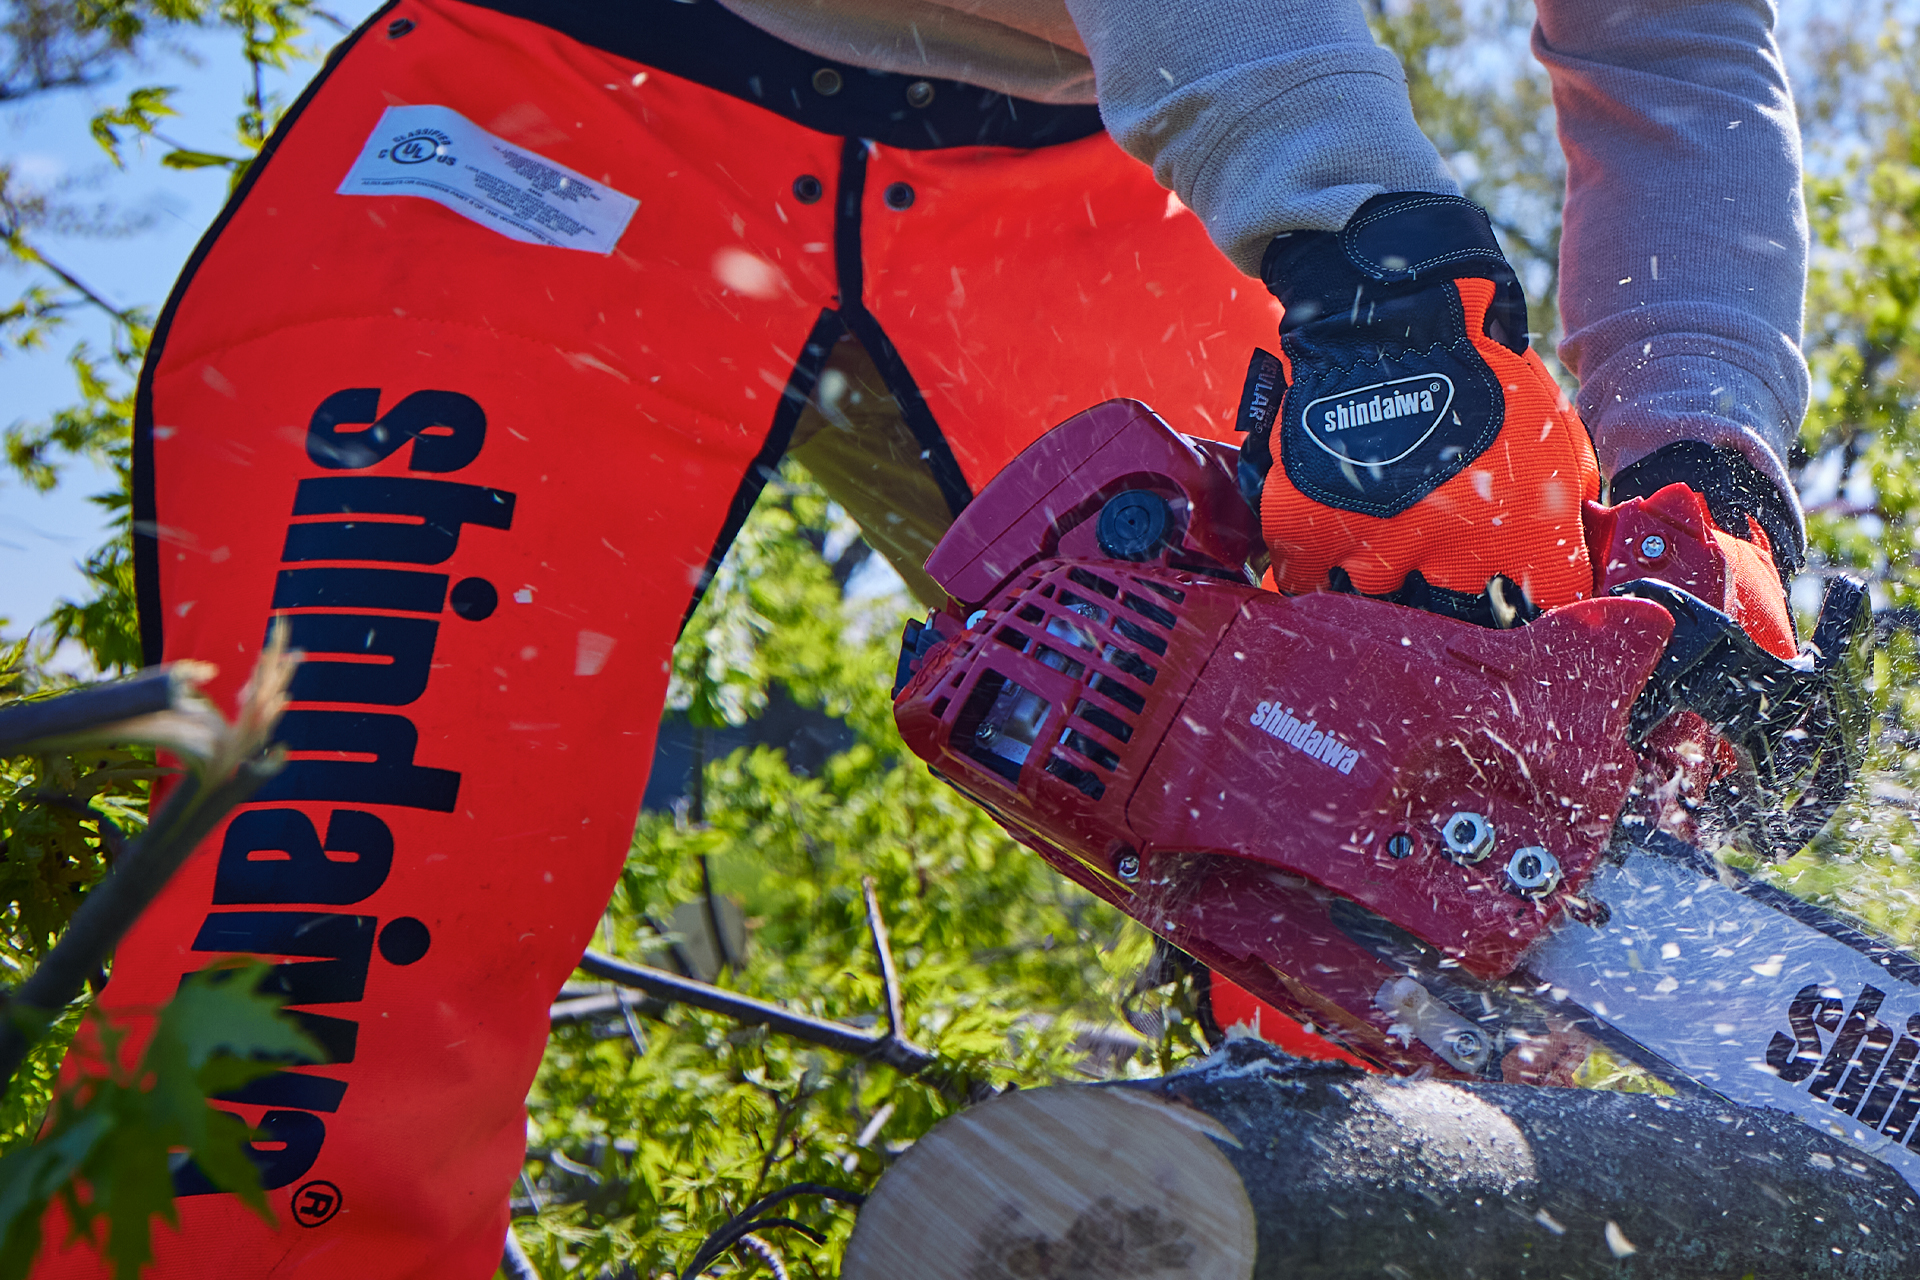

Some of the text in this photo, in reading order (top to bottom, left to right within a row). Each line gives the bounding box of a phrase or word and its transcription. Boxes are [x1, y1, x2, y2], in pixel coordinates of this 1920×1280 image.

[392, 128, 453, 146] CLASSIFIED
[402, 143, 423, 159] UL
[436, 155, 457, 167] US
[1250, 701, 1359, 776] shindaiwa
